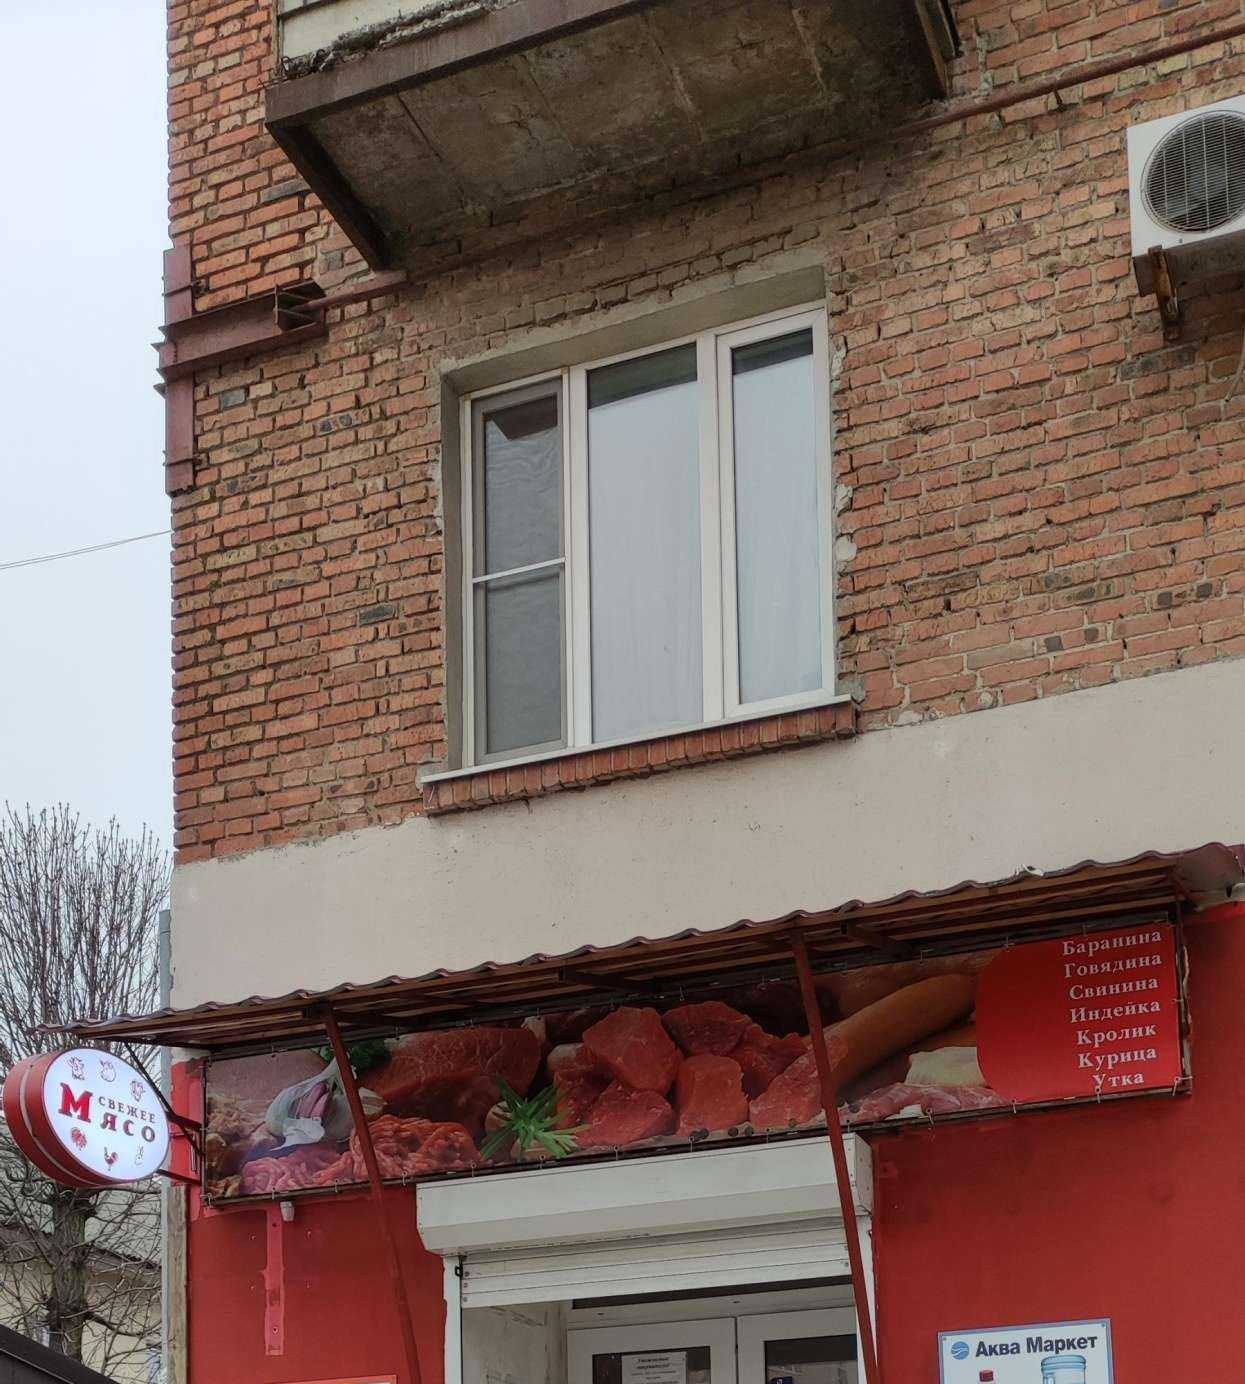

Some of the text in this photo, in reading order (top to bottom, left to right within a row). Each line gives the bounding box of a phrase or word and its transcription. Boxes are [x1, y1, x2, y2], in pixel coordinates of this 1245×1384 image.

[1061, 930, 1162, 957] Баранина
[1063, 954, 1163, 979] Говядина
[1068, 978, 1159, 1000] Свинина
[1069, 1000, 1161, 1024] Индейка
[1076, 1023, 1157, 1047] Кролик
[1077, 1046, 1157, 1072] Курица
[1093, 1072, 1145, 1088] Утка
[98, 1096, 156, 1124] СВЕЖЕЕ
[975, 1336, 1098, 1357] Аква Маркет
